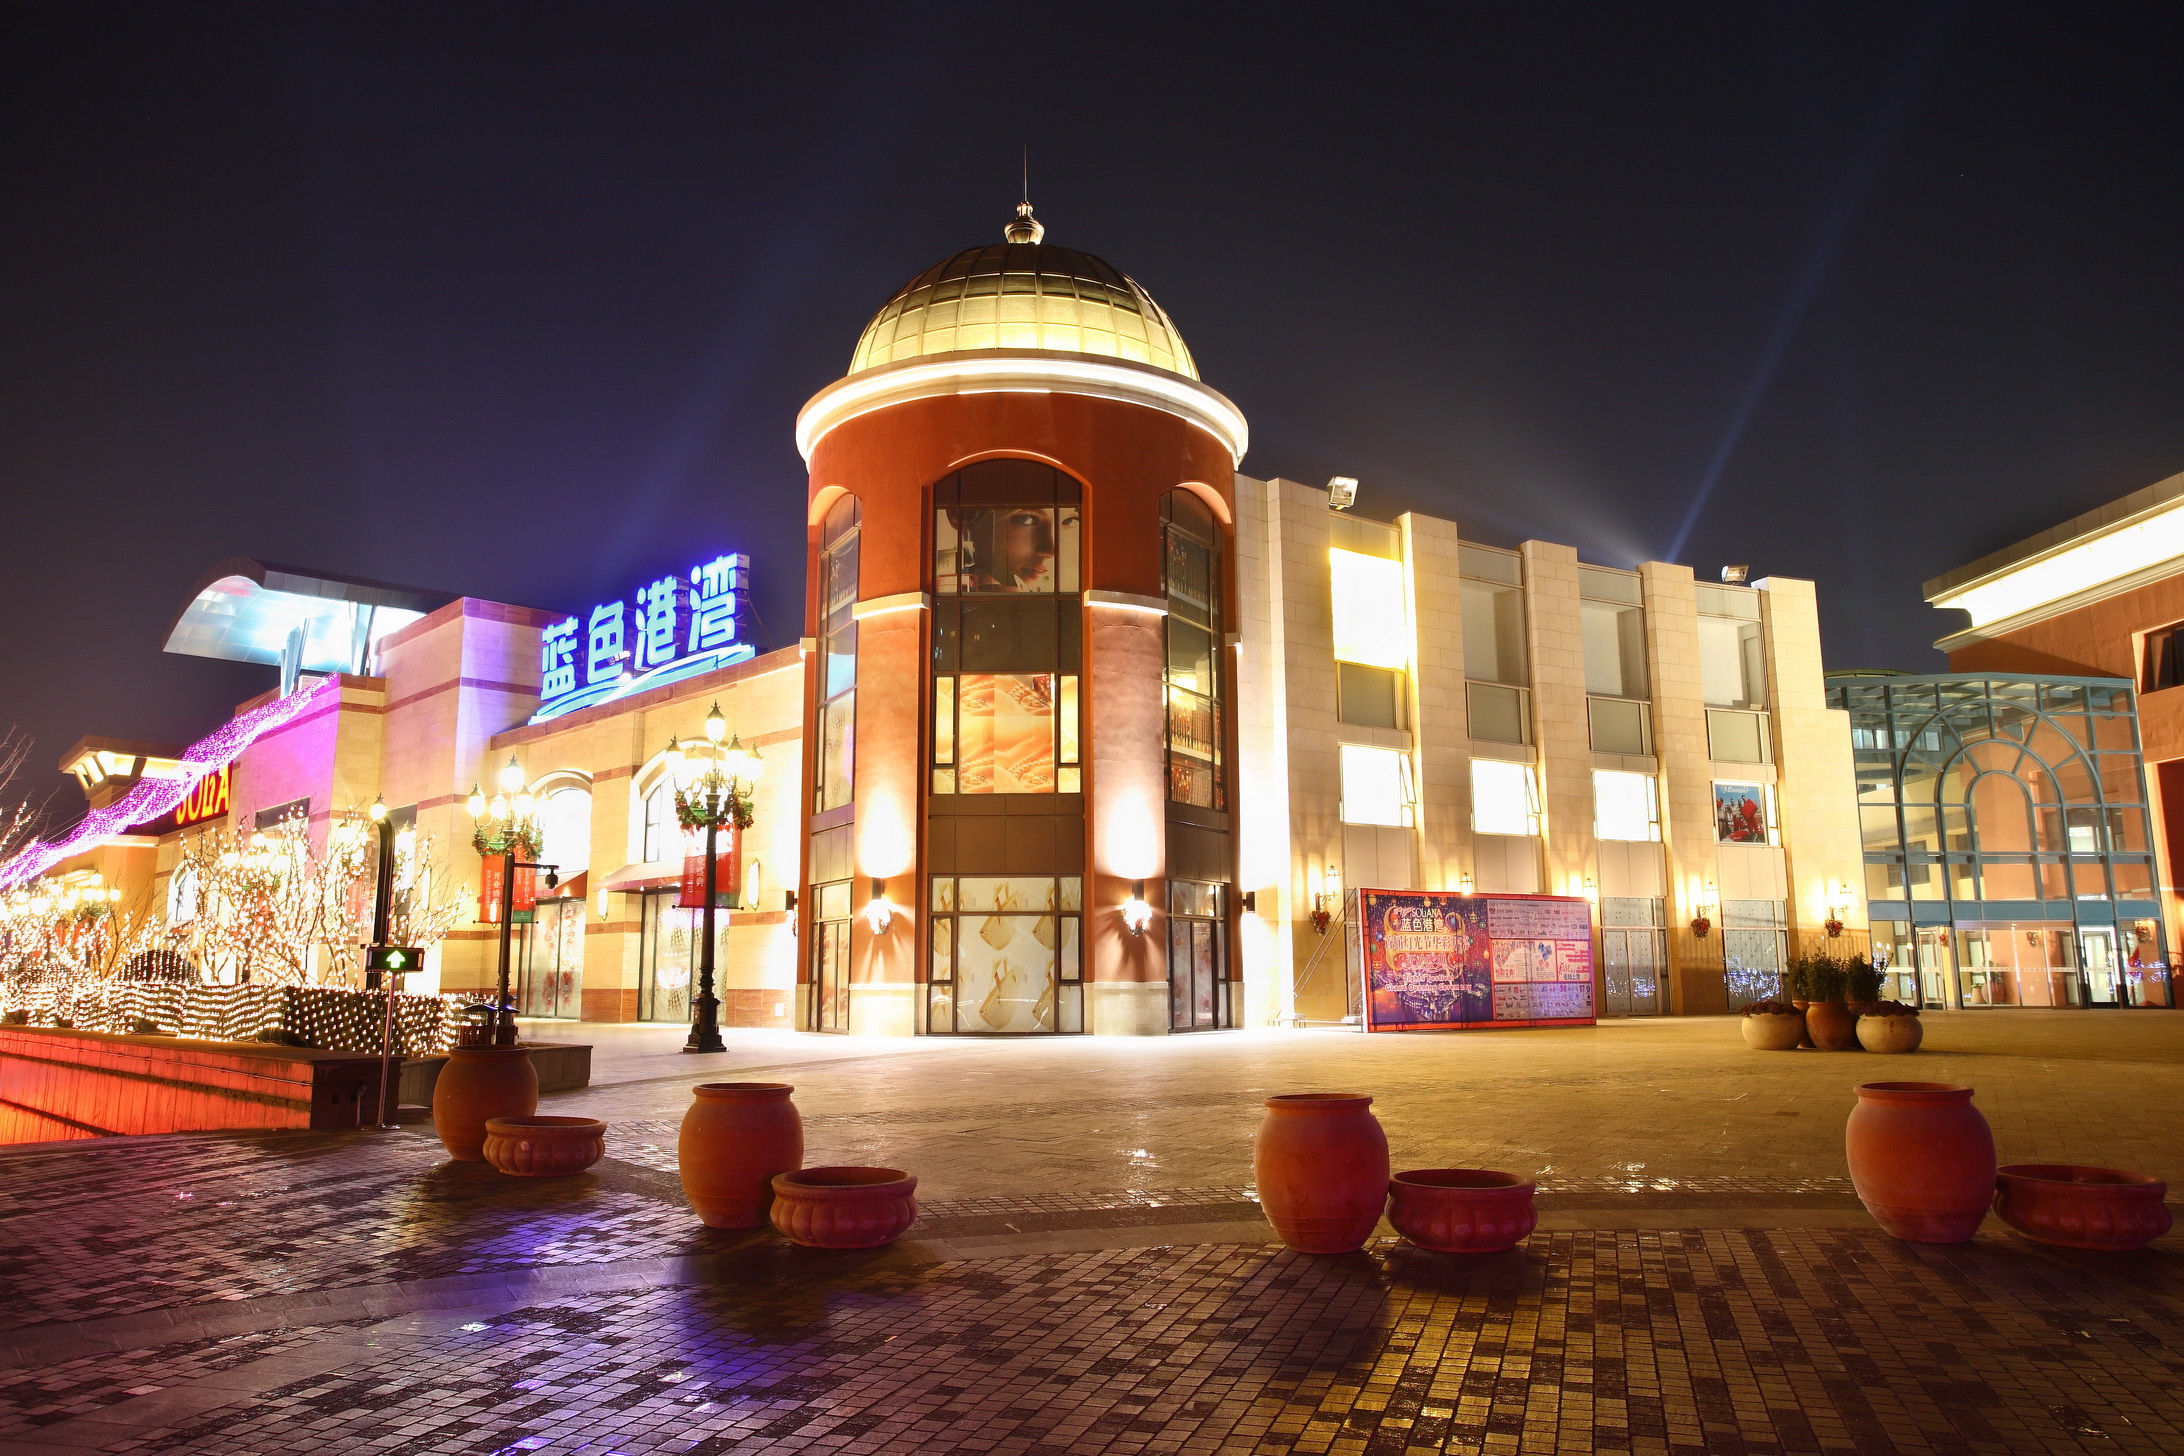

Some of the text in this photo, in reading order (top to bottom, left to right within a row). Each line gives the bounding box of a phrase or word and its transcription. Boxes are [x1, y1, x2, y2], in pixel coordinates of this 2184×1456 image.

[540, 552, 738, 700] 蓝色港湾
[1401, 918, 1445, 932] 蓝色港湾
[1427, 974, 1454, 982] Festival
[1385, 983, 1472, 993] Grand Opening Ceremony
